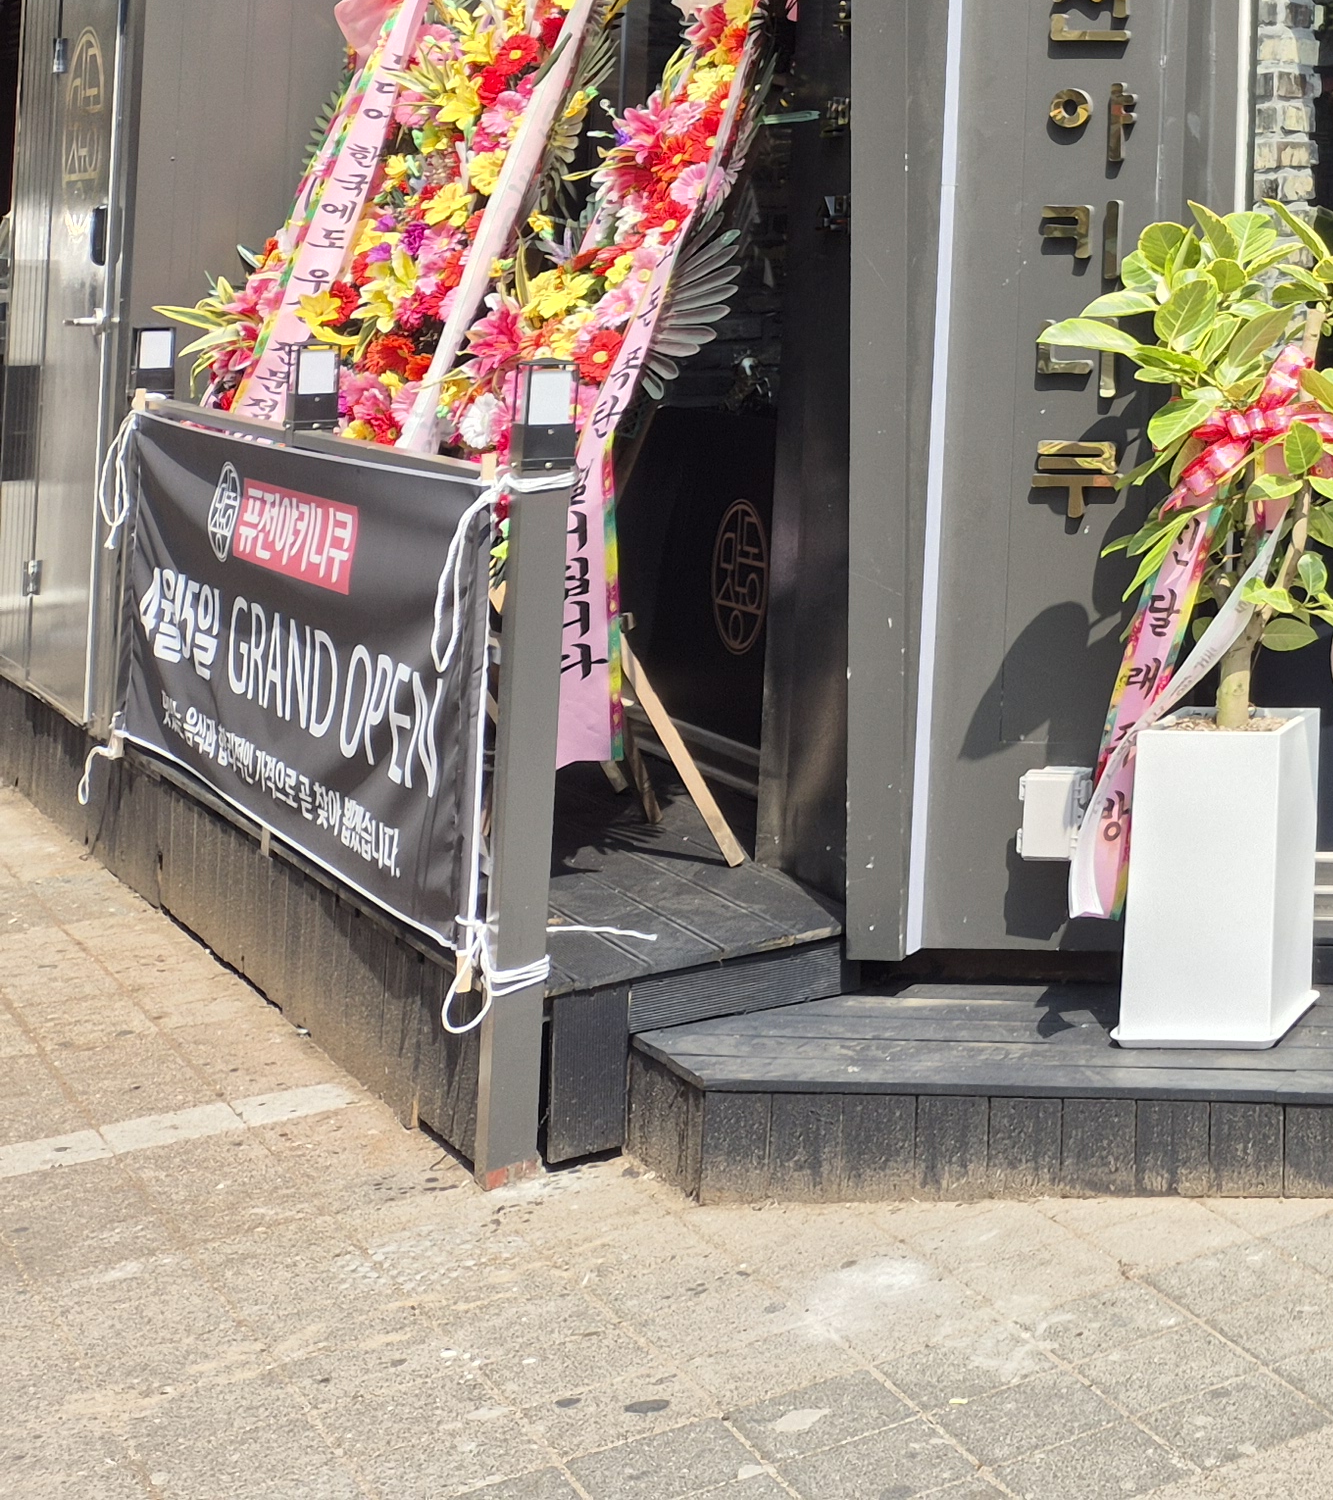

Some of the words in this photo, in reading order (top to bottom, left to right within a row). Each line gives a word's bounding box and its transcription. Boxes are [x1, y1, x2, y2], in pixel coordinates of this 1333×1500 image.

[307, 142, 379, 251] 한국에도
[238, 486, 354, 584] 퓨전야키니쿠
[139, 566, 221, 681] 4월5일
[228, 595, 339, 739] GRAND
[339, 643, 444, 798] OPEN
[184, 706, 217, 755] 음식과
[217, 725, 255, 785] 합리적인
[255, 748, 298, 809] 가격으로
[298, 774, 313, 821] 곧
[313, 781, 342, 831] 찾아
